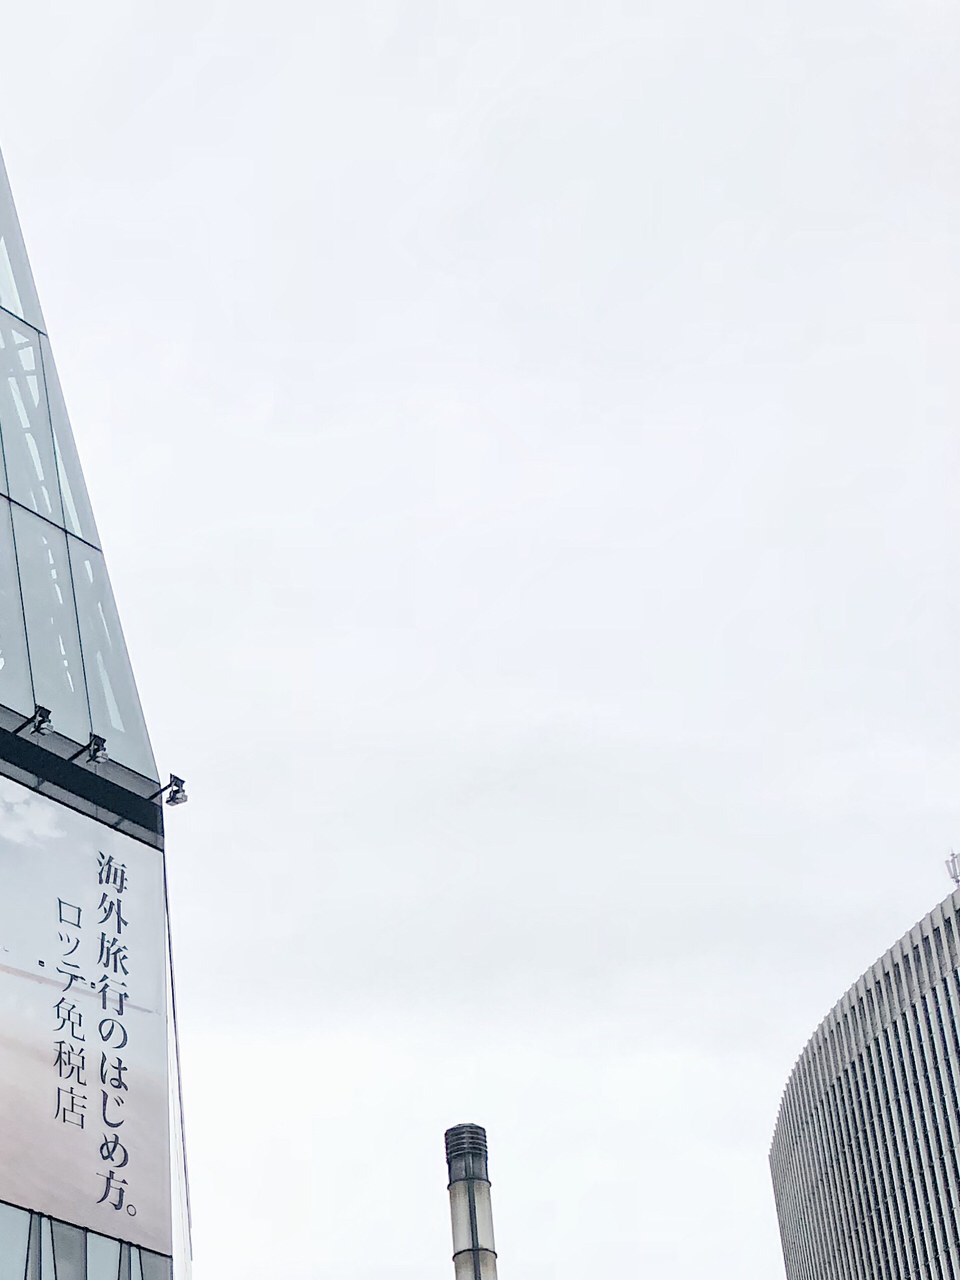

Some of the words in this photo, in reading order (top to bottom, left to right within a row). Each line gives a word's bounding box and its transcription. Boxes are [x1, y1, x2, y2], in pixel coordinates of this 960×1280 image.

[52, 896, 88, 1130] ロッテ免税店
[95, 849, 138, 1218] 海外旅行のはじめ方。
